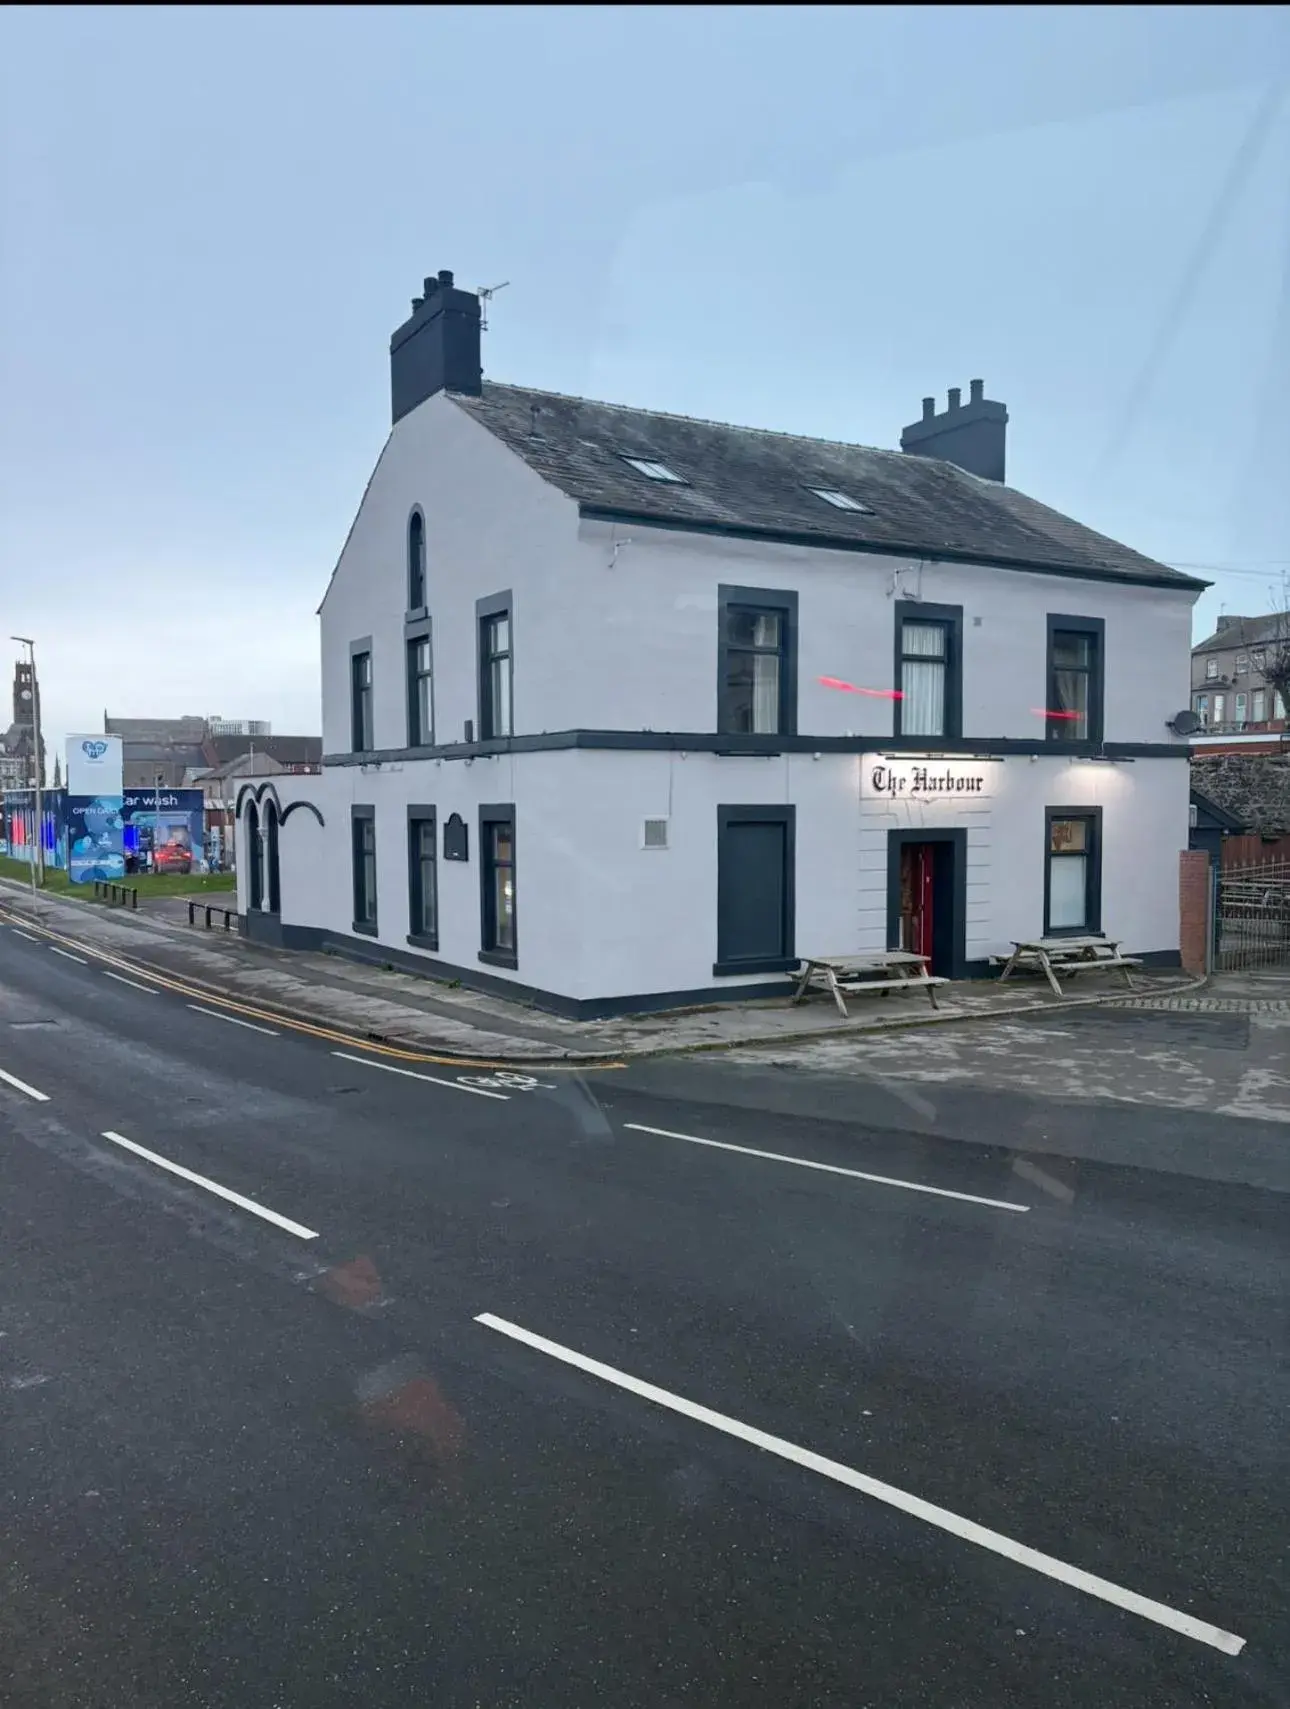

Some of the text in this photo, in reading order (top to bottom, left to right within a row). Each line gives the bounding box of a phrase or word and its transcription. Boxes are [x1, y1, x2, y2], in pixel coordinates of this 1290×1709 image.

[872, 765, 984, 800] The Harbour
[142, 794, 178, 806] wash
[72, 807, 96, 815] OPEN
